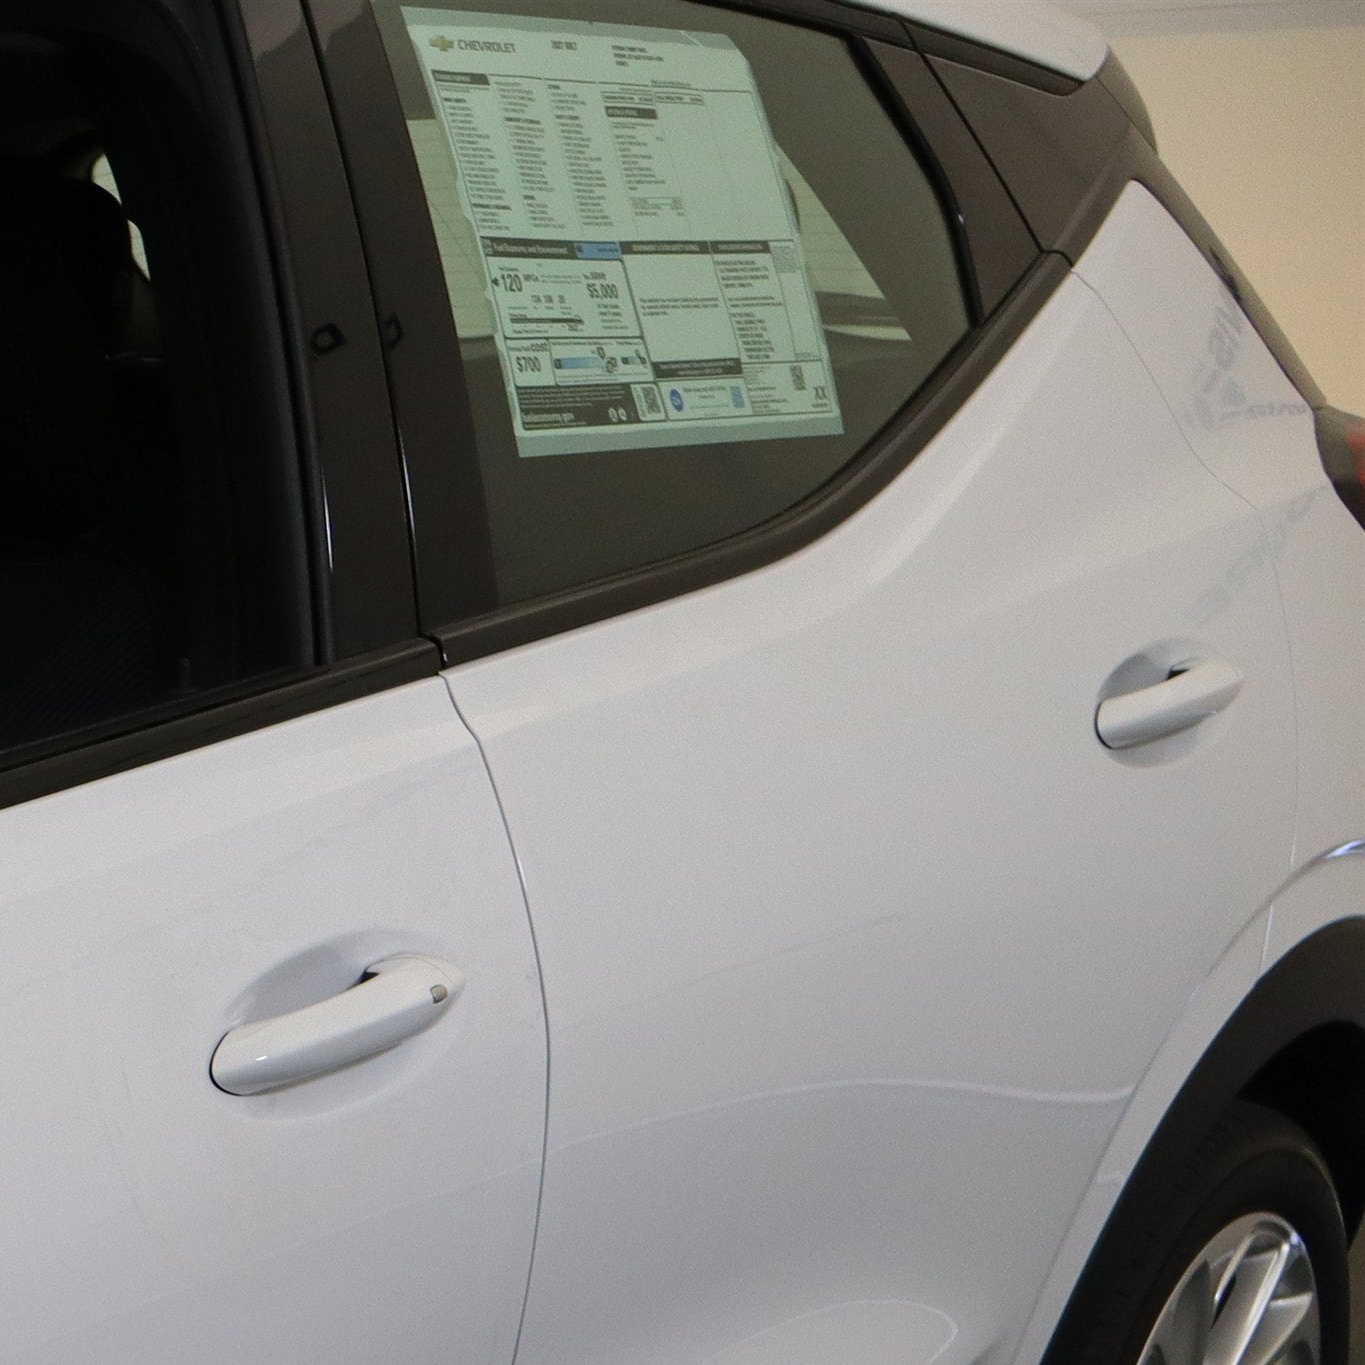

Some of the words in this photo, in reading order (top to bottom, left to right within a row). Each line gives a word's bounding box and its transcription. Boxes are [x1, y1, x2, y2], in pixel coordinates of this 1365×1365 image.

[457, 39, 517, 54] CHEVROLET
[501, 273, 523, 292] 120
[586, 283, 619, 299] $5,000
[516, 356, 542, 373] $700
